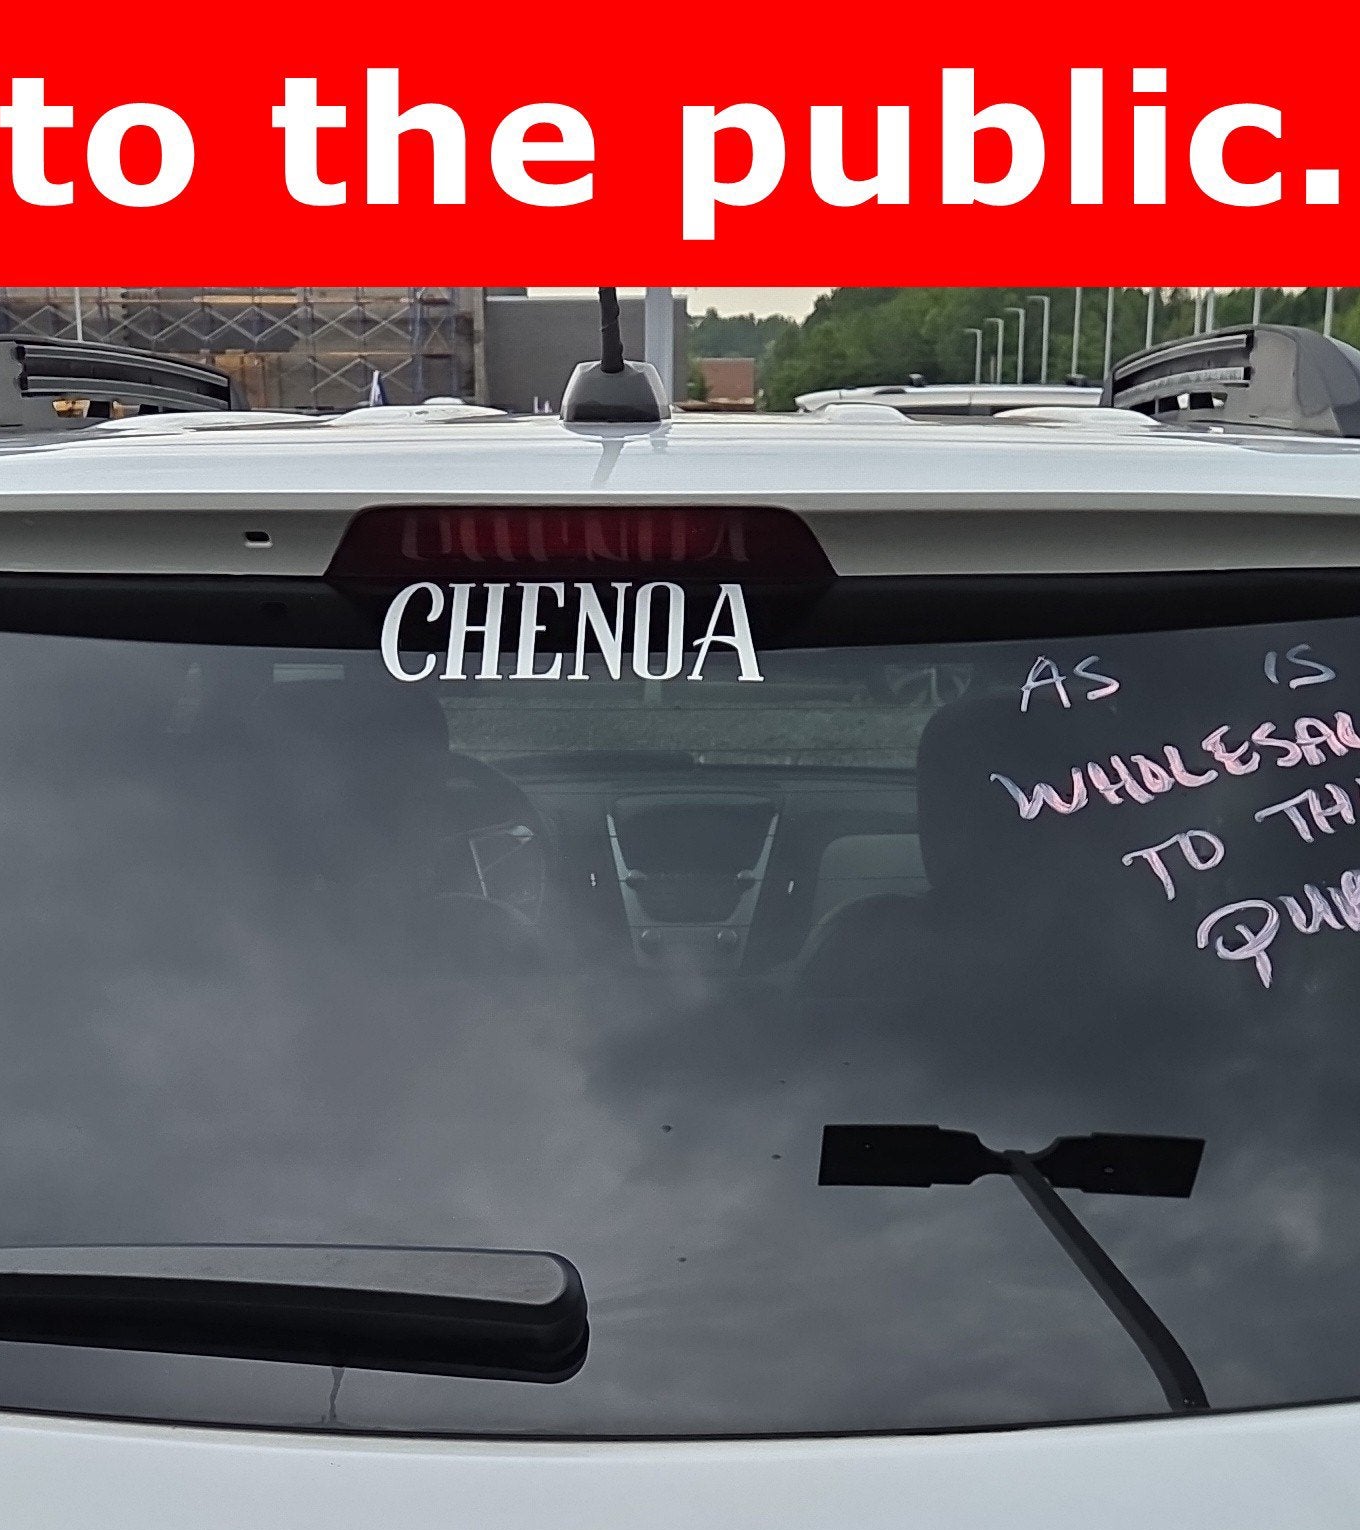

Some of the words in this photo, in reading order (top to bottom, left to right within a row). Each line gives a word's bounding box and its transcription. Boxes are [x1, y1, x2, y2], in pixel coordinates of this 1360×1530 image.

[381, 581, 765, 682] CHENOA
[1020, 656, 1120, 712] AS
[1263, 644, 1336, 689] IS
[1122, 829, 1225, 900] TO
